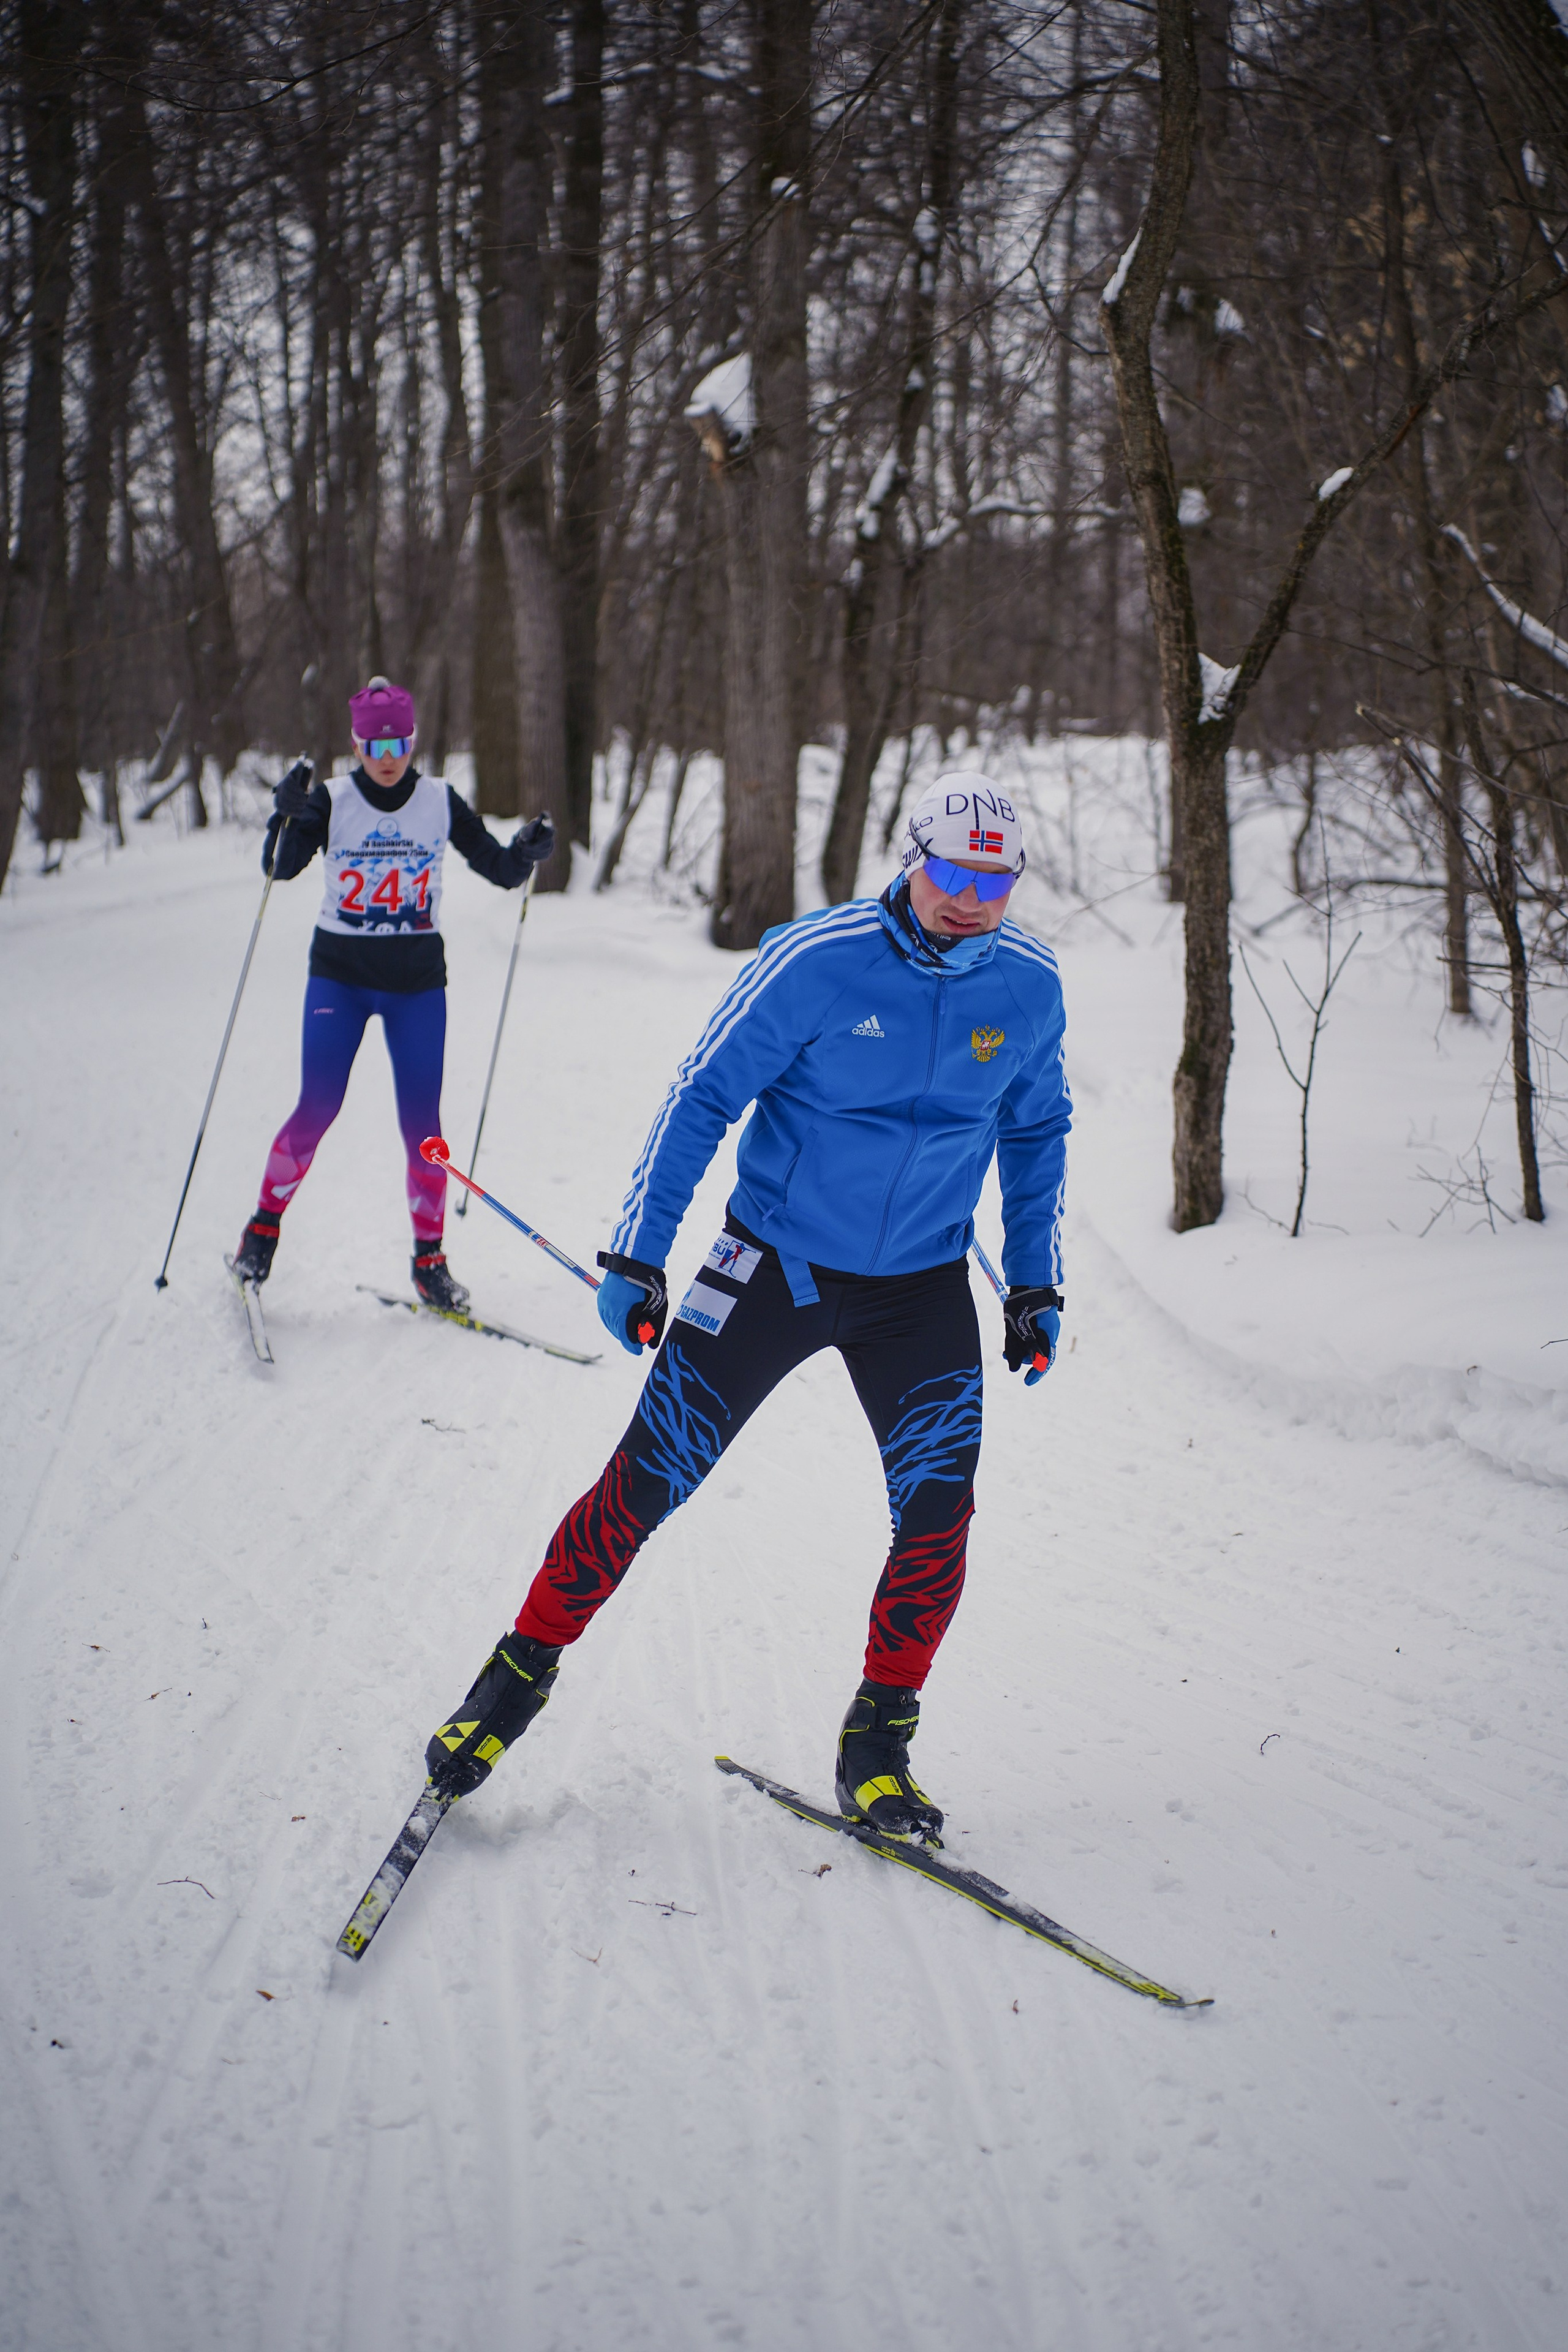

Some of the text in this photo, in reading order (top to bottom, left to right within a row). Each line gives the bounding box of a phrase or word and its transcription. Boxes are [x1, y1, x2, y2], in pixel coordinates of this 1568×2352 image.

[946, 789, 1015, 830] DNB
[339, 869, 429, 913] 241
[851, 1027, 885, 1038] adidas
[680, 1305, 720, 1332] GAZPROM
[499, 1649, 533, 1682] FISCHER
[887, 1715, 919, 1726] FISCHER
